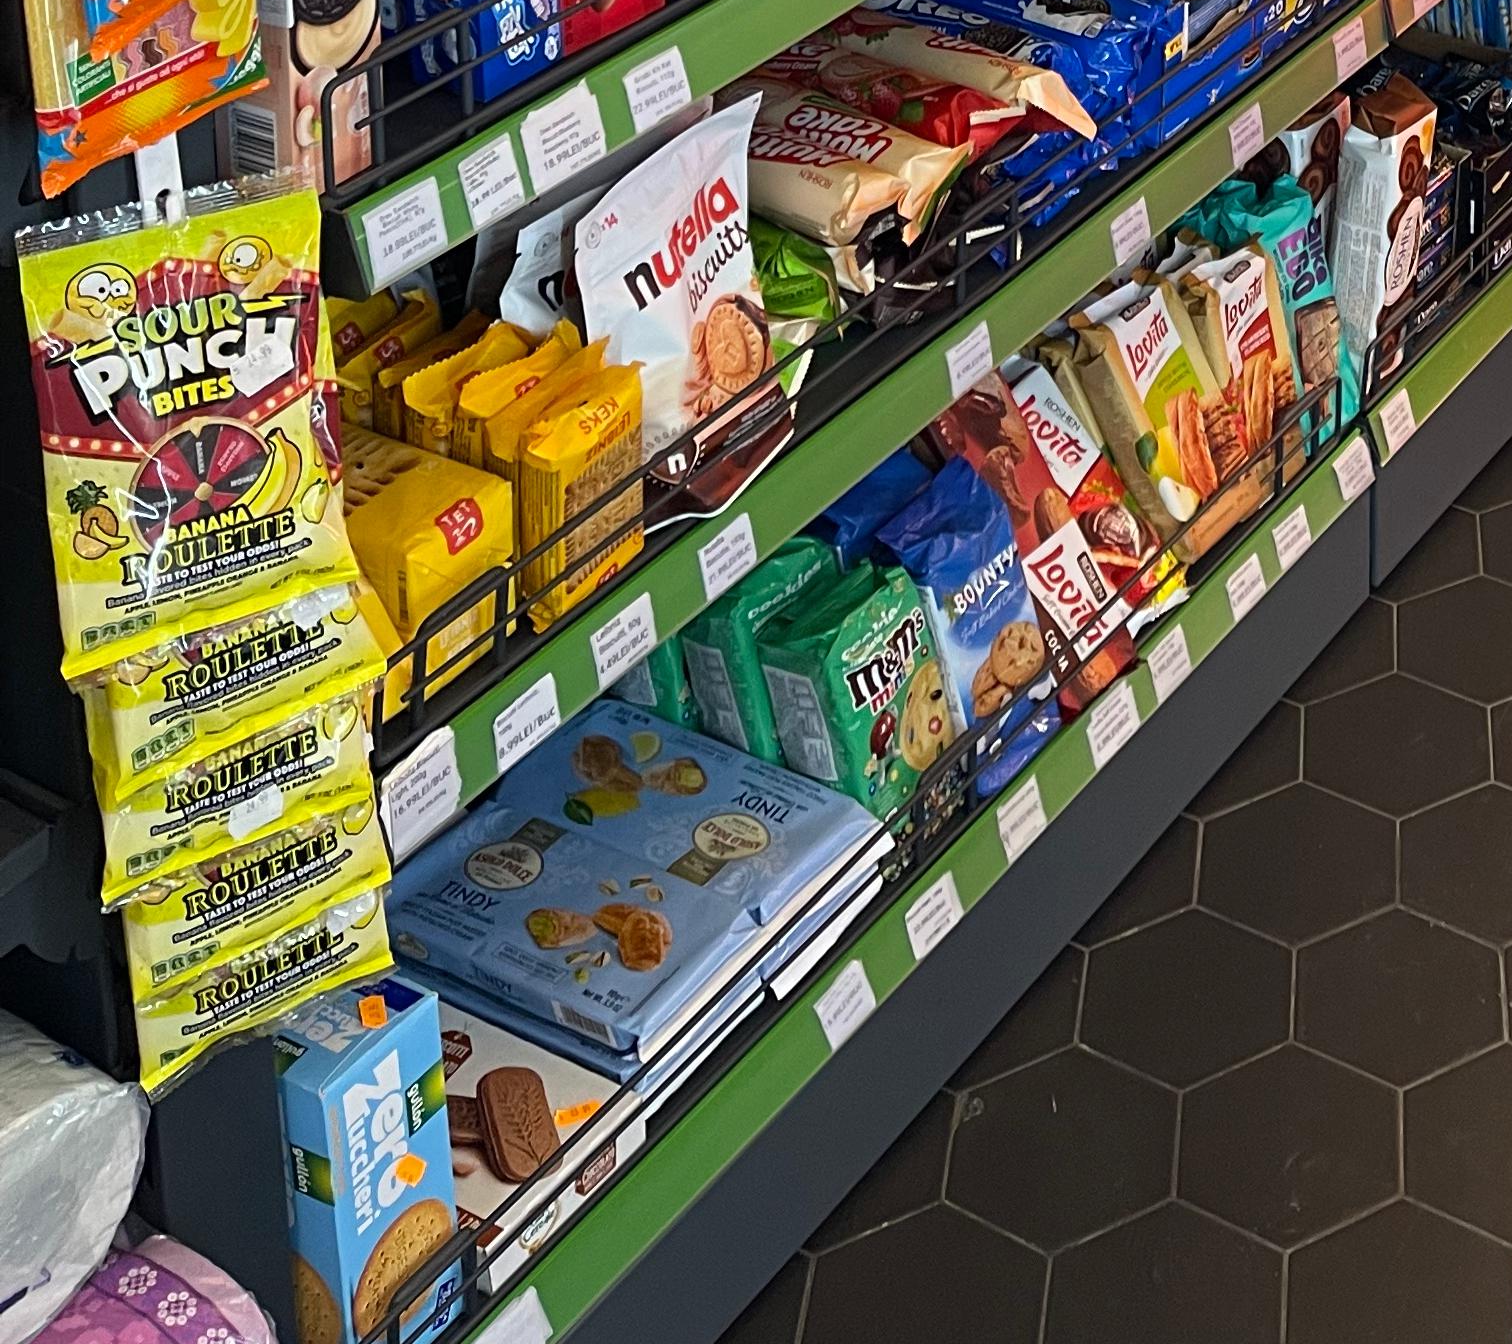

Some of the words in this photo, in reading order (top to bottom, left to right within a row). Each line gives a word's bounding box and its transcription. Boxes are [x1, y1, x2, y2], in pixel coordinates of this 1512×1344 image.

[624, 174, 741, 312] nutella
[686, 221, 752, 315] biscuits
[117, 296, 242, 353] SOUR
[1224, 272, 1264, 342] Lovita
[74, 316, 296, 418] PUNCH
[1125, 309, 1170, 382] Lovita
[152, 376, 236, 418] BITES
[123, 511, 296, 585] ROULETTE
[165, 506, 253, 545] BANANA
[190, 562, 214, 577] TEST
[214, 552, 246, 571] YOUR
[245, 540, 281, 560] ODDS!
[953, 542, 1018, 616] BOUNTY
[1027, 543, 1108, 647] Lovita
[169, 727, 318, 811] ROULETTE
[733, 790, 792, 825] TINDY
[186, 829, 338, 918] ROULETTE
[439, 879, 500, 912] TINDY
[341, 1050, 417, 1202] Zero
[348, 1113, 381, 1237] Zuccheri
